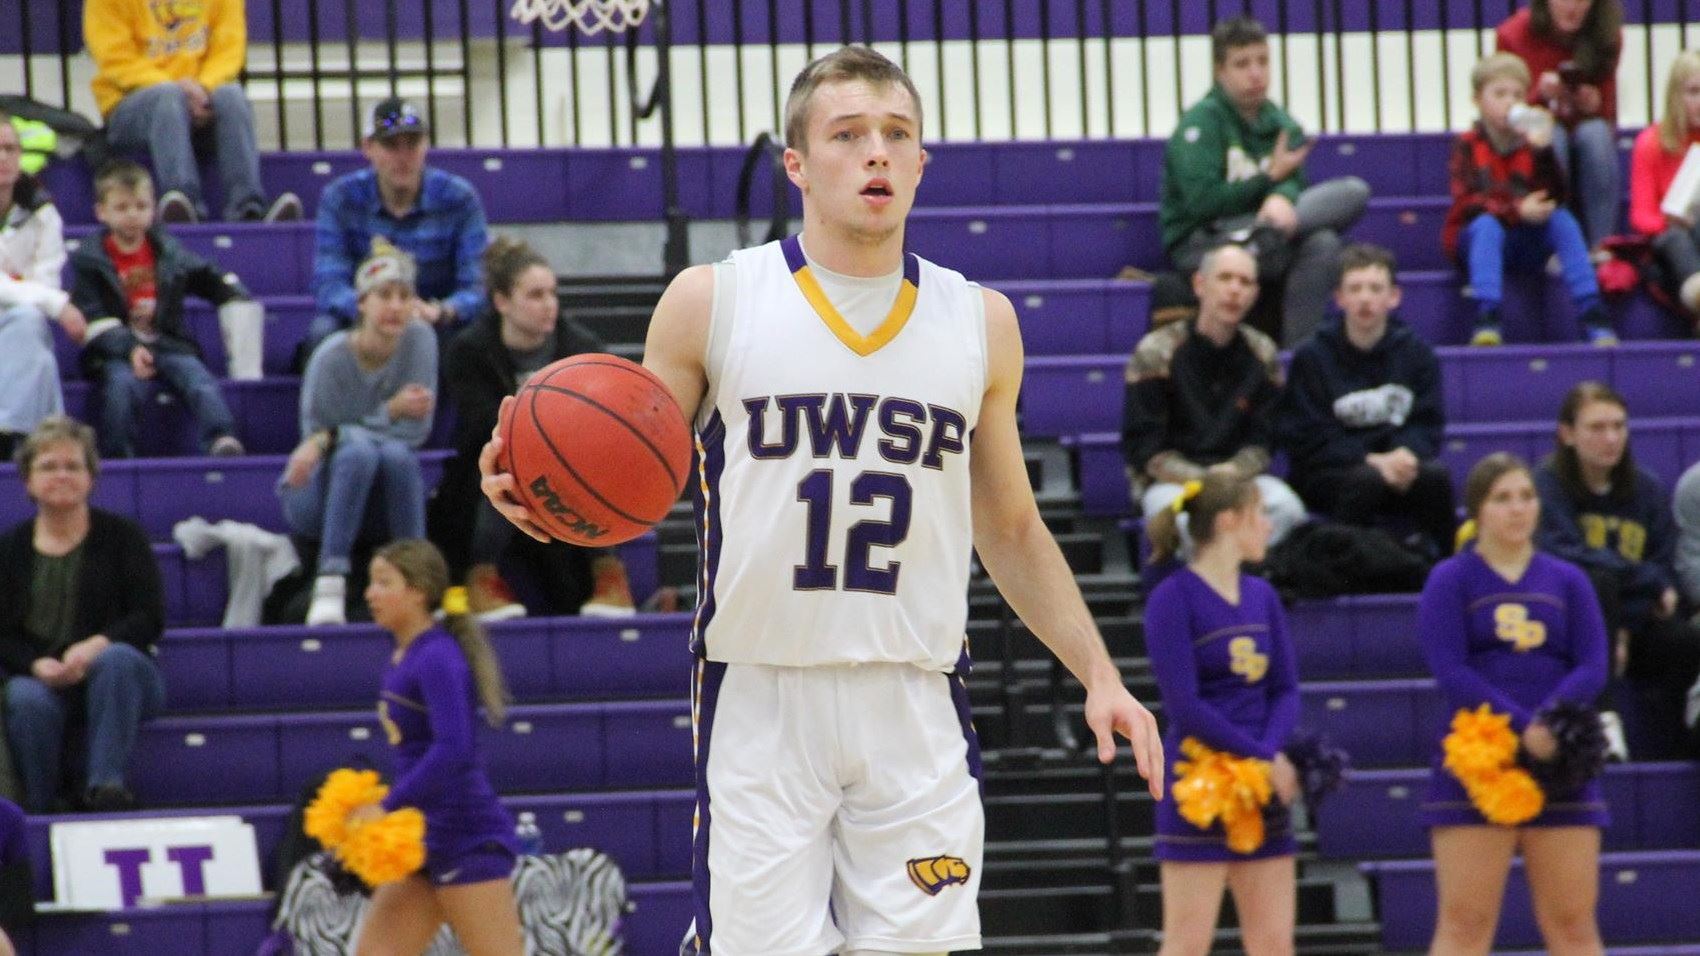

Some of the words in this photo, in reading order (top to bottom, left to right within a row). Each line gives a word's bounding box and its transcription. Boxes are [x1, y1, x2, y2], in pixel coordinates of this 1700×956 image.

[742, 392, 967, 470] UWSP
[529, 475, 610, 539] NCAA
[792, 468, 913, 595] 12
